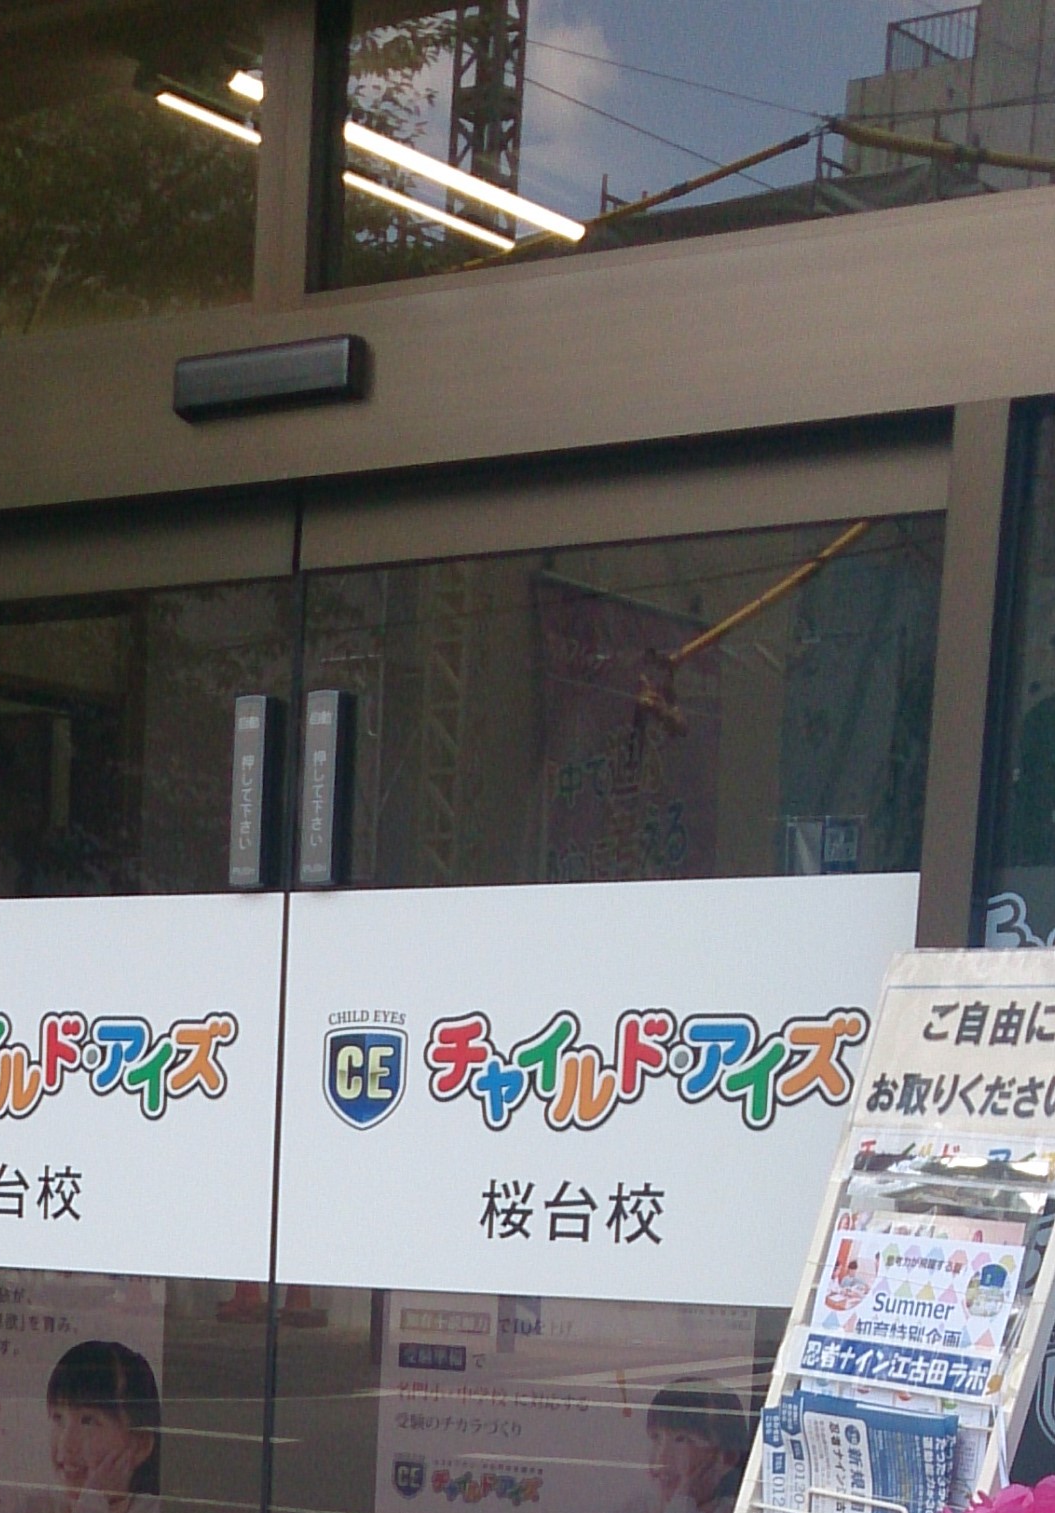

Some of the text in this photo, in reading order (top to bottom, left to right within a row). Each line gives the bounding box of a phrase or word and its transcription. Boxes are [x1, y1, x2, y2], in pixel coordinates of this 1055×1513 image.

[239, 755, 256, 850] 押して下さい
[310, 750, 328, 847] 押して下さい
[328, 1009, 406, 1026] CHILD EYES
[922, 1000, 1055, 1047] ご自由に
[336, 1045, 393, 1100] CE
[479, 1178, 666, 1245] 桜台校
[872, 1292, 955, 1321] Summer
[800, 1339, 989, 1395] 忍者ナイン江古田ラボ
